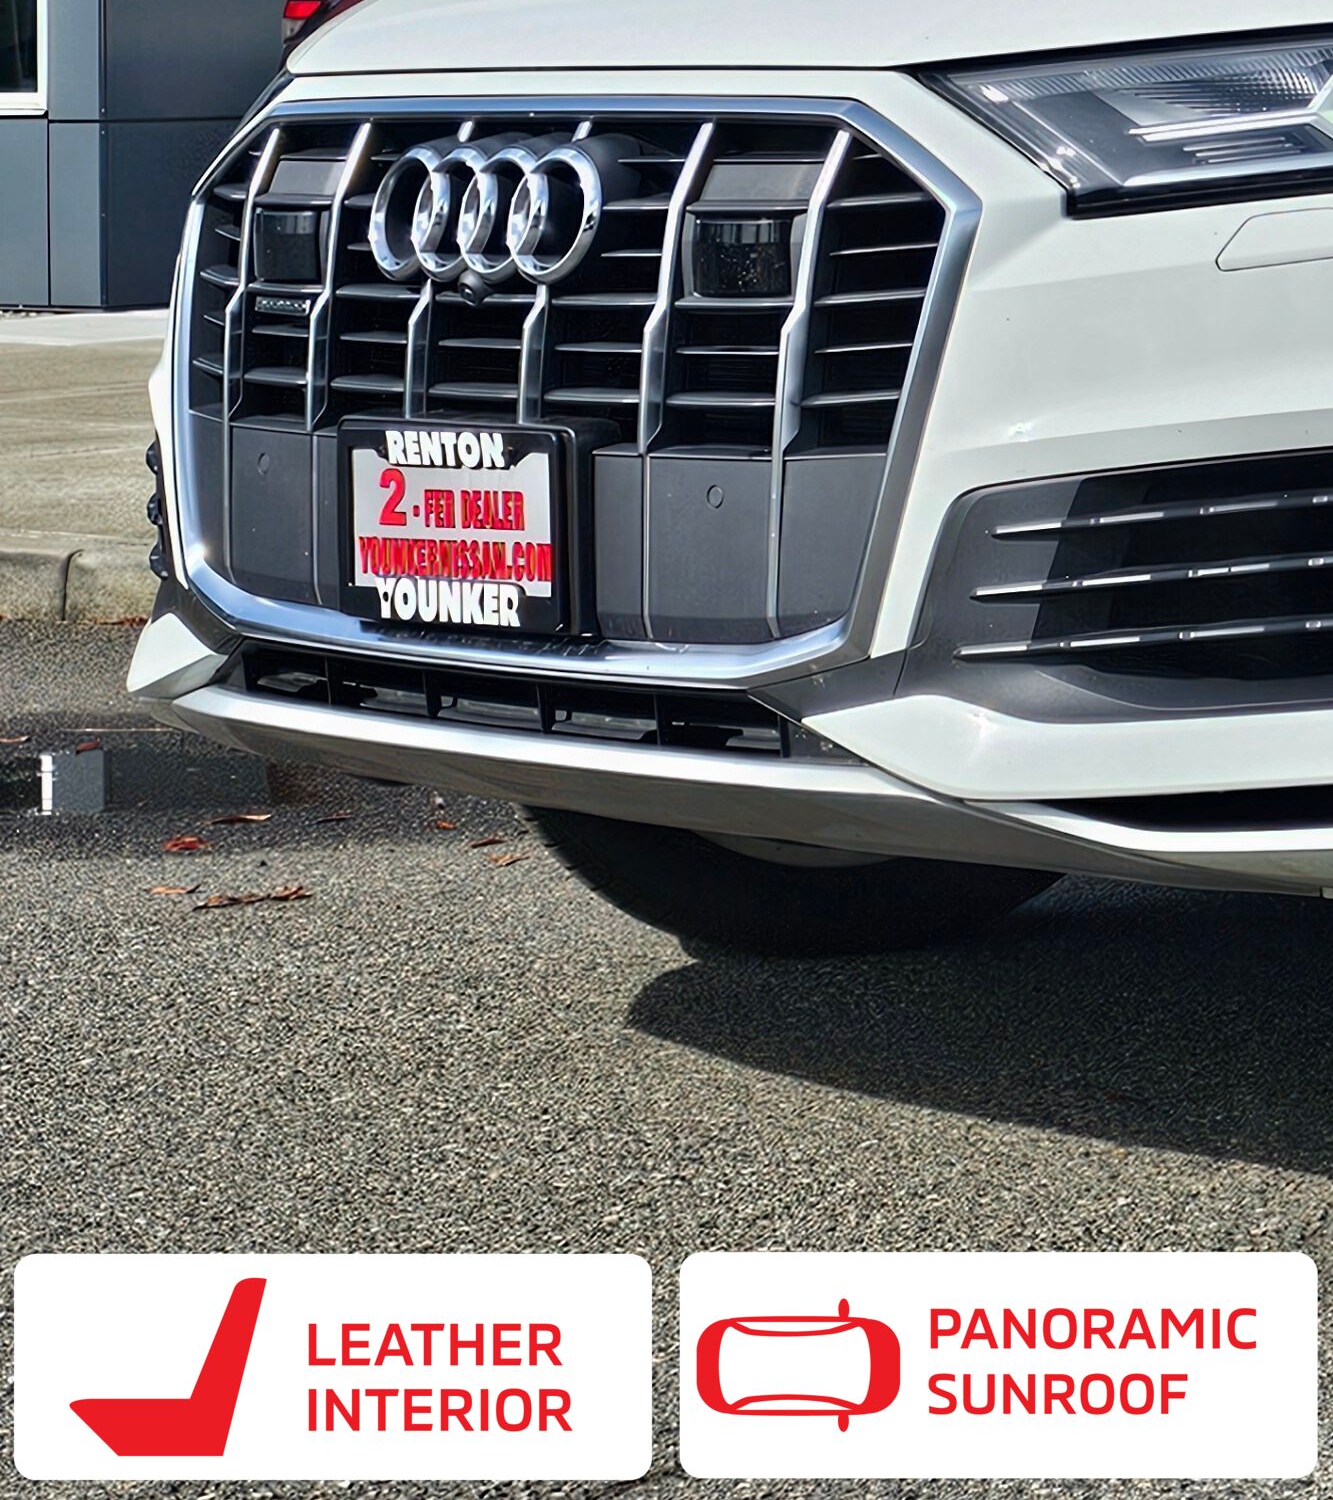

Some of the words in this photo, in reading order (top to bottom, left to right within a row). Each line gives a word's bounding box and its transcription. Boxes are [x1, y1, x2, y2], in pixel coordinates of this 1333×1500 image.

[385, 430, 506, 468] RENTON
[460, 490, 526, 532] DEALER
[358, 536, 553, 582] YOUNKERNISSAN.COM
[374, 576, 521, 628] YOUNKER
